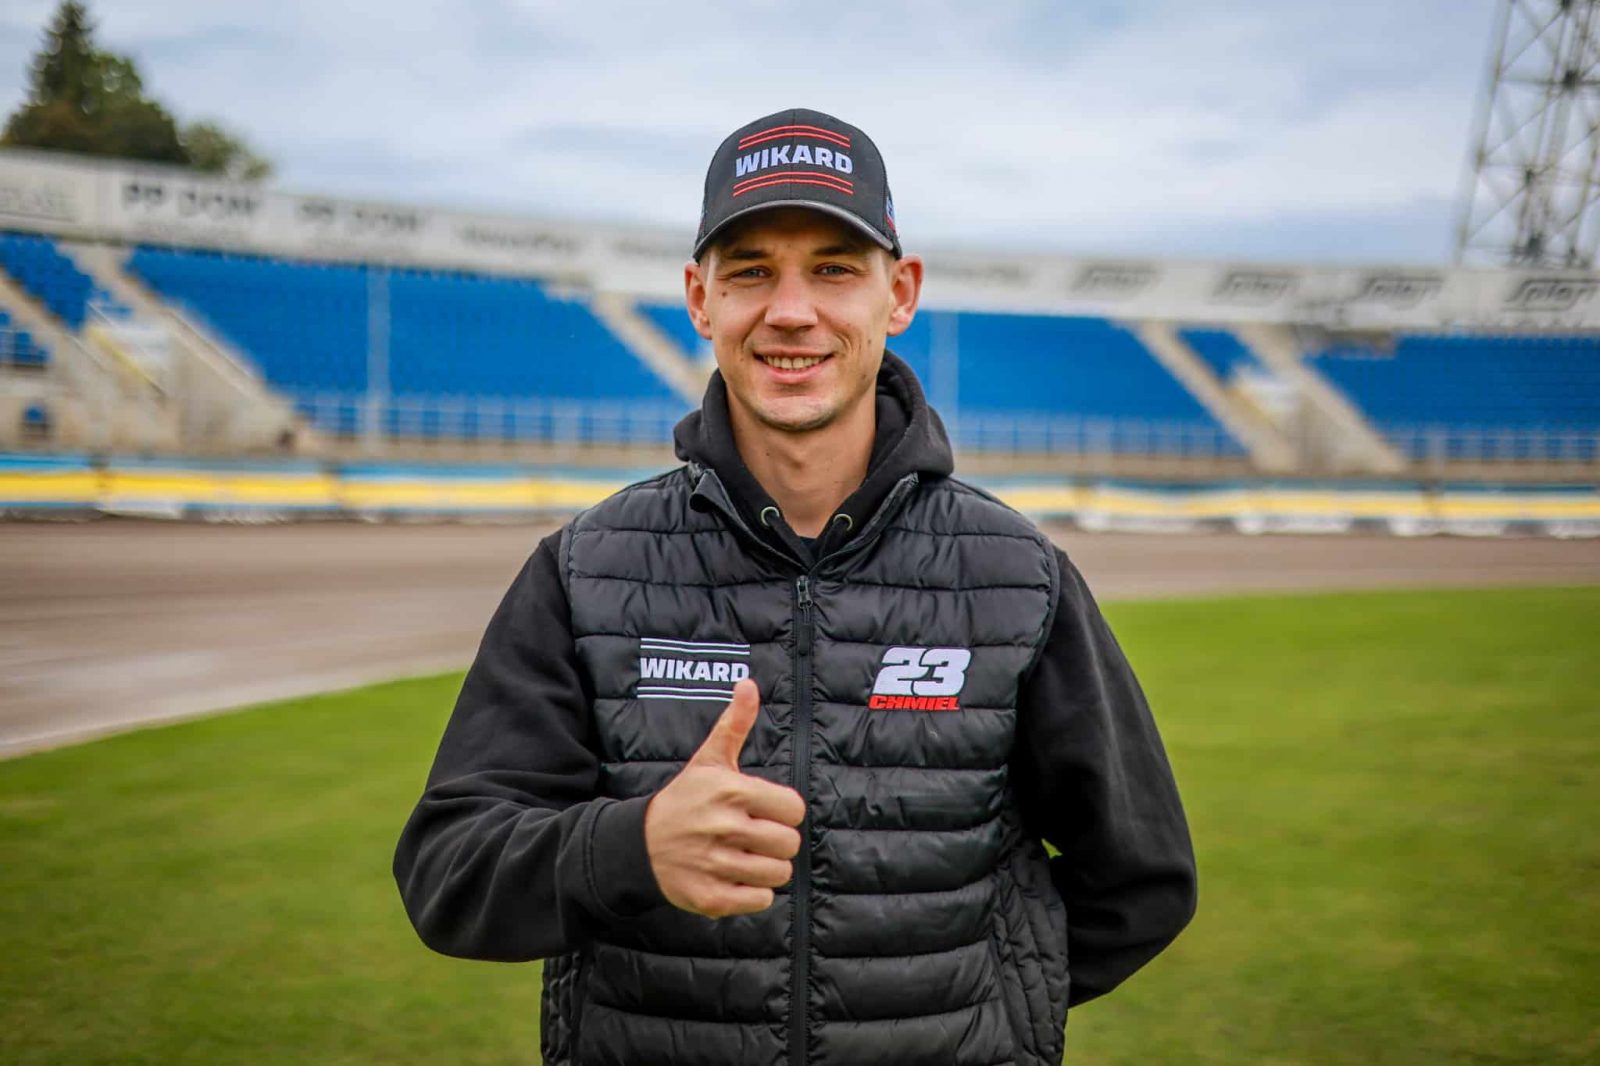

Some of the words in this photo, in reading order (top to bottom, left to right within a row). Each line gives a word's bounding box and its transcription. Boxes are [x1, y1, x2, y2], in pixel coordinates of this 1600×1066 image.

[735, 144, 853, 178] WIKARD
[640, 657, 750, 682] WIKARD
[871, 646, 971, 696] 23
[868, 694, 960, 711] CHMIEL
